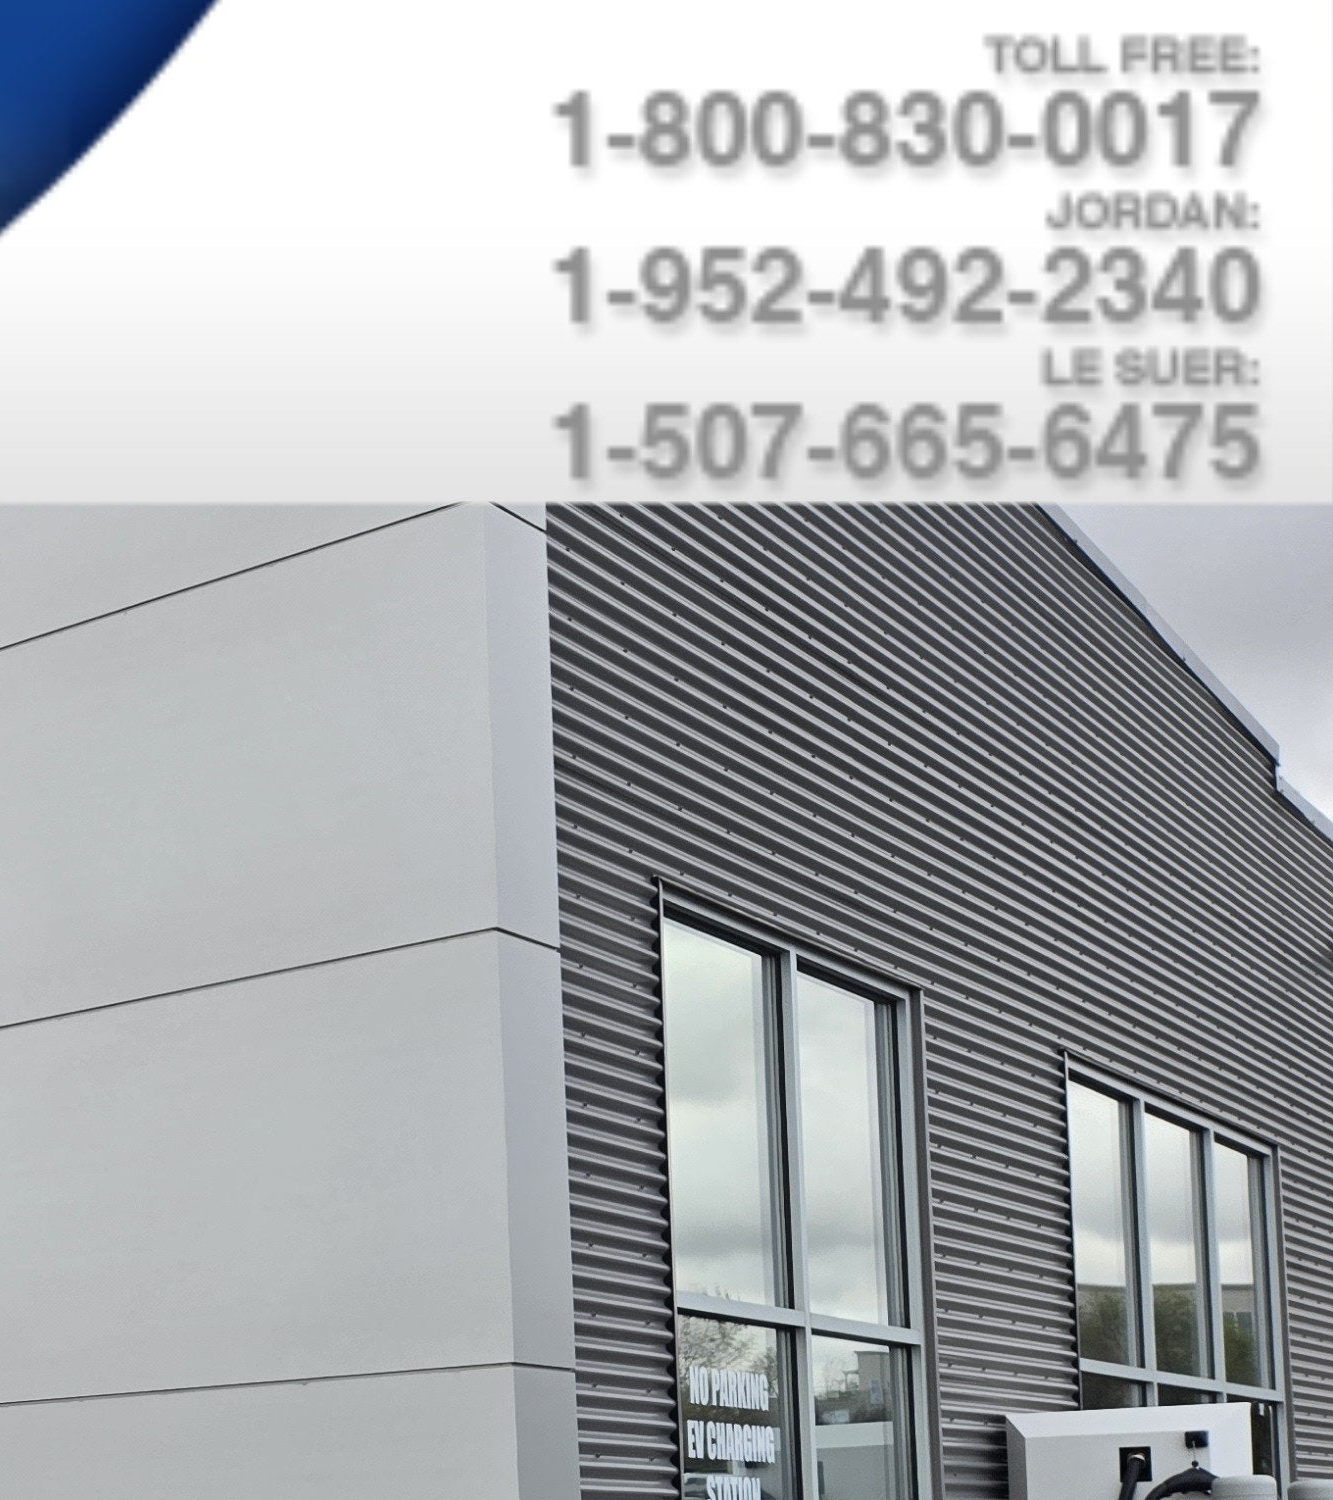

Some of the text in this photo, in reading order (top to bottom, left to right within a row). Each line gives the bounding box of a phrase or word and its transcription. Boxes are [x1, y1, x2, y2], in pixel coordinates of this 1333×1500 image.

[689, 1365, 770, 1412] NO PARKING
[686, 1419, 776, 1464] EV CHARGING
